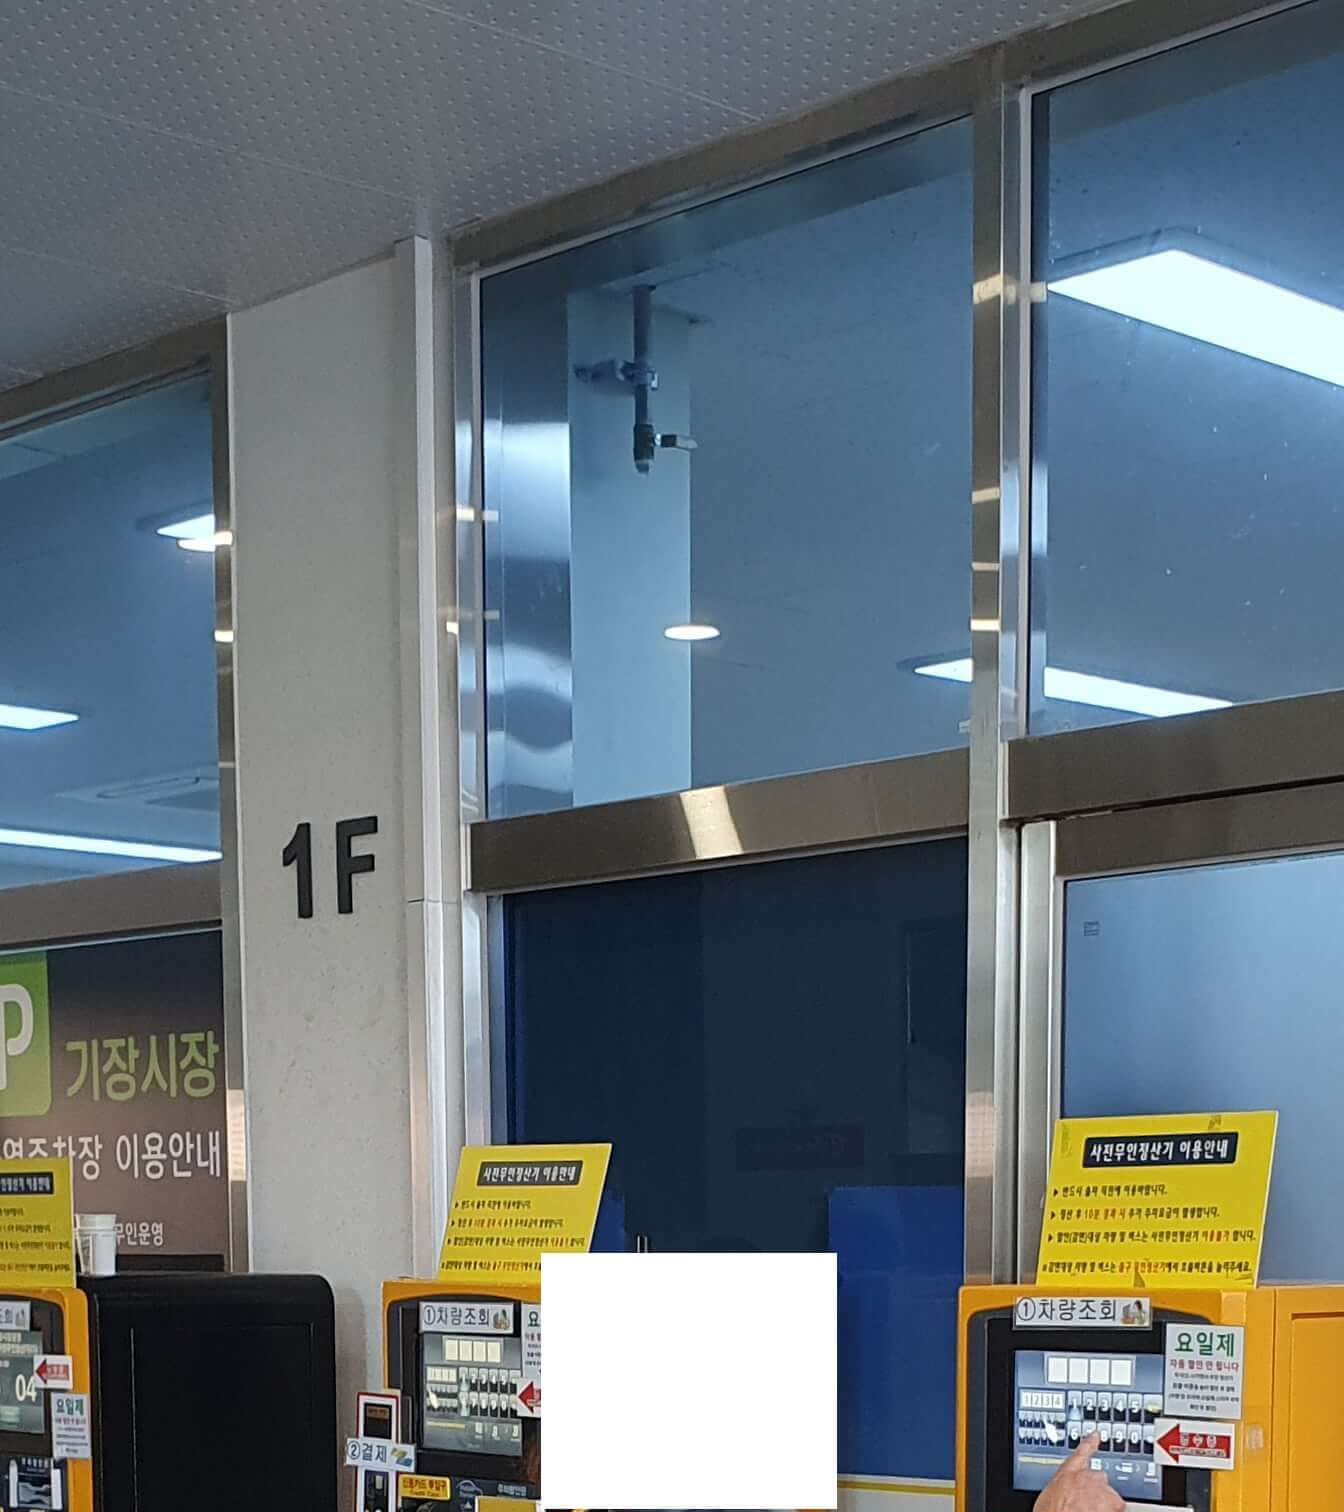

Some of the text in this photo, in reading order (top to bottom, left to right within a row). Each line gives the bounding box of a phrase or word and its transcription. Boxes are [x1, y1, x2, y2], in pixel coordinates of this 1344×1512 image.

[280, 815, 378, 919] 1F
[64, 1029, 220, 1103] 기장시장
[115, 1130, 222, 1181] 이용안내
[1174, 1331, 1235, 1358] 요일제
[15, 1375, 38, 1403] 04
